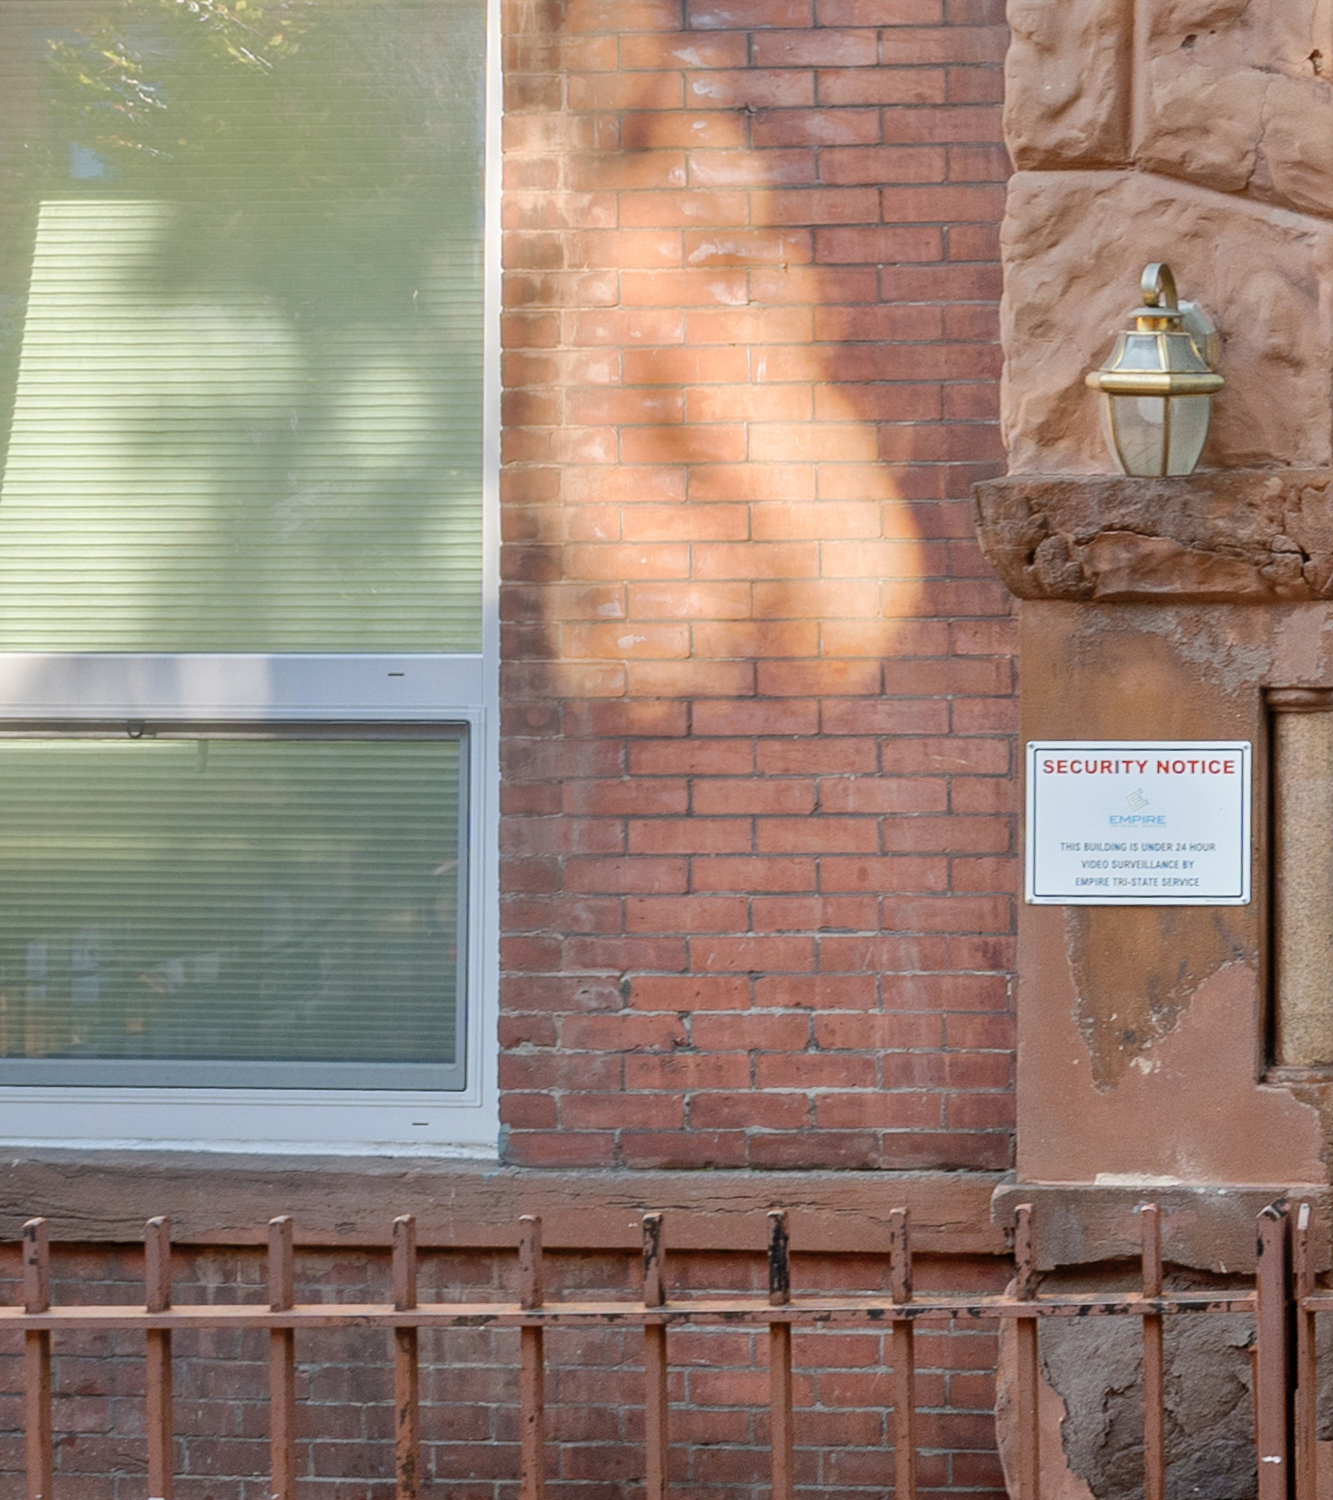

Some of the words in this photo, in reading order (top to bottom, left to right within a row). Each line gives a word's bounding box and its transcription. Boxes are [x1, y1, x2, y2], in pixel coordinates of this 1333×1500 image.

[1042, 759, 1149, 774] SECURITY
[1156, 759, 1236, 774] NOTICE
[1109, 815, 1167, 825] EMPIRE
[1060, 842, 1081, 852] THIS
[1083, 842, 1128, 852] BUILDING
[1129, 842, 1140, 852] IS
[1141, 842, 1174, 852] UNDER
[1175, 842, 1187, 852] 24
[1189, 842, 1217, 852] HOUR
[1081, 859, 1110, 869] VIDEO
[1111, 859, 1180, 869] SURVEILLANCE
[1182, 859, 1195, 869] BY
[1075, 877, 1110, 887] EMPIRE
[1113, 877, 1159, 887] TRI-STATE
[1161, 877, 1200, 887] SERVICE
